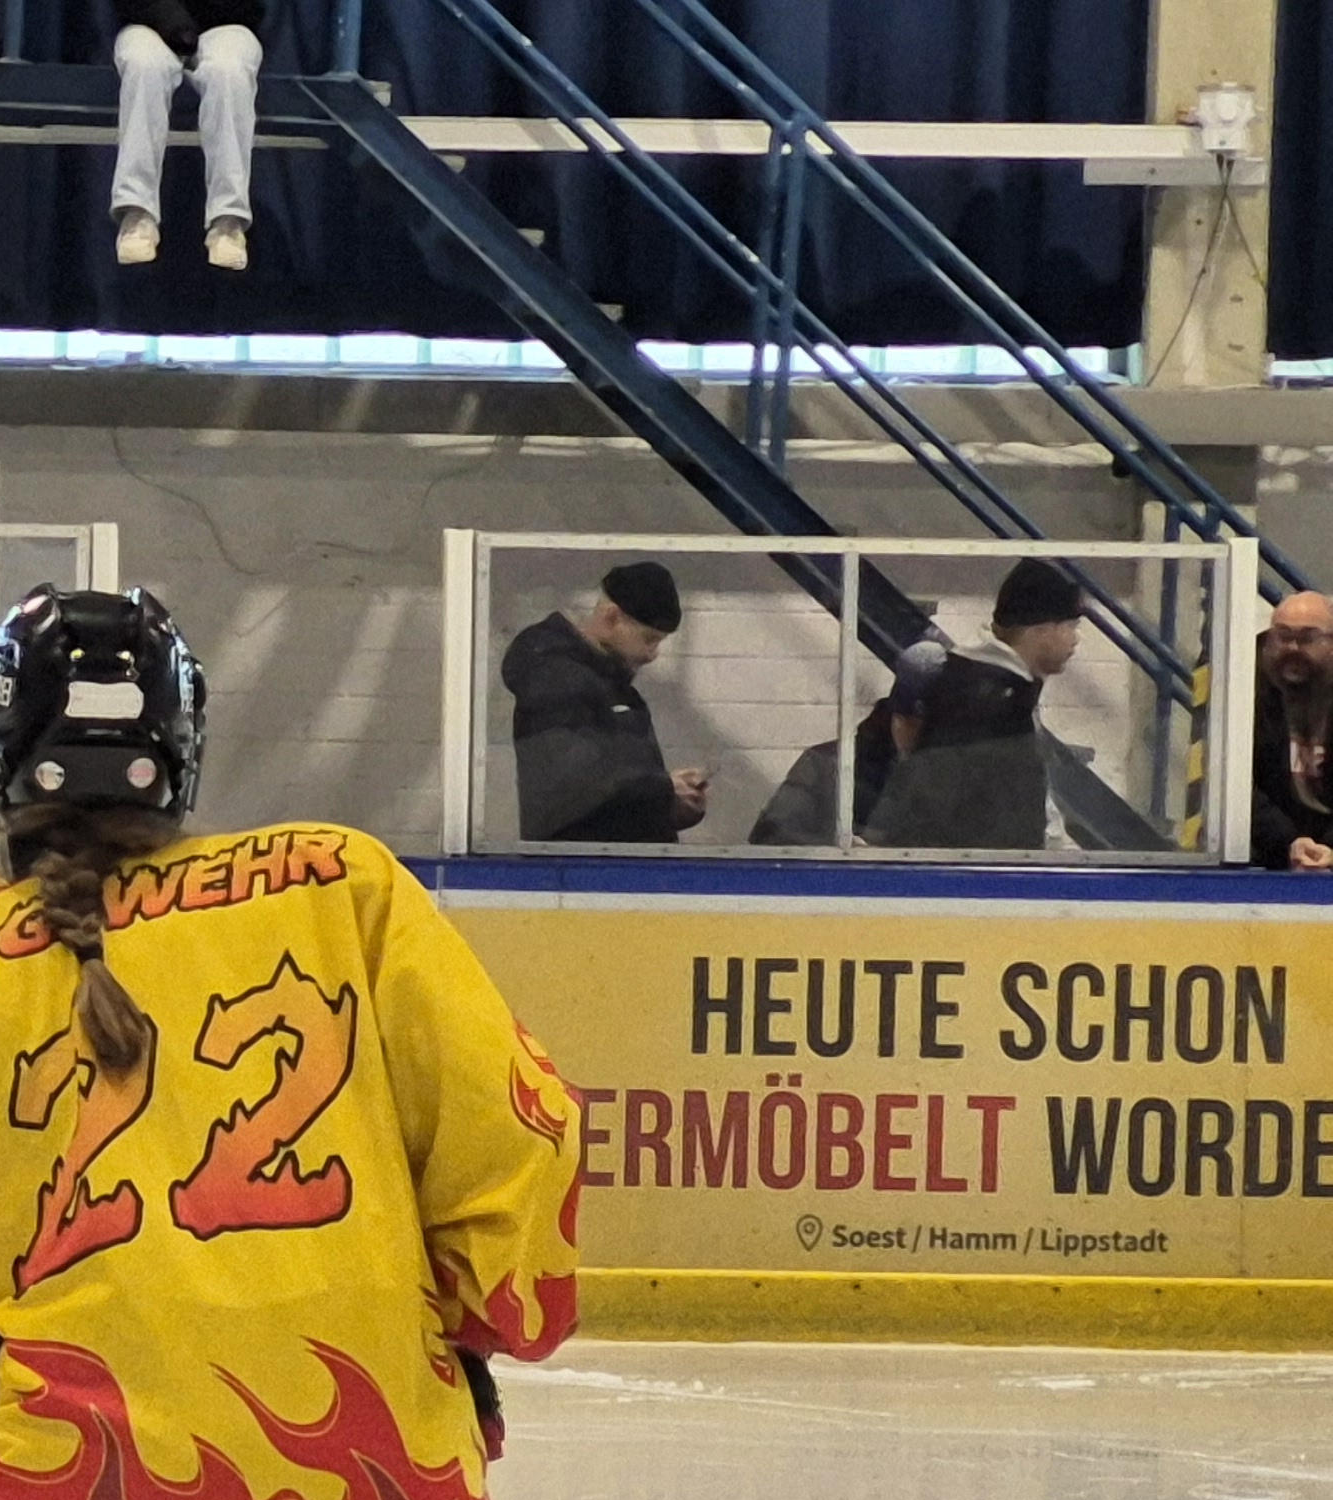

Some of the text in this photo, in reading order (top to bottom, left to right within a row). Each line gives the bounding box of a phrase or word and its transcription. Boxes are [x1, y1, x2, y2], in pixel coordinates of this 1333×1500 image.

[691, 956, 1288, 1064] HEUTE SCHON
[9, 952, 359, 1300] 22
[581, 1073, 1017, 1194] ERMÖBELT
[833, 1224, 907, 1250] Soest
[929, 1227, 1017, 1251] Hamm
[1040, 1228, 1169, 1257] Lippstadt
